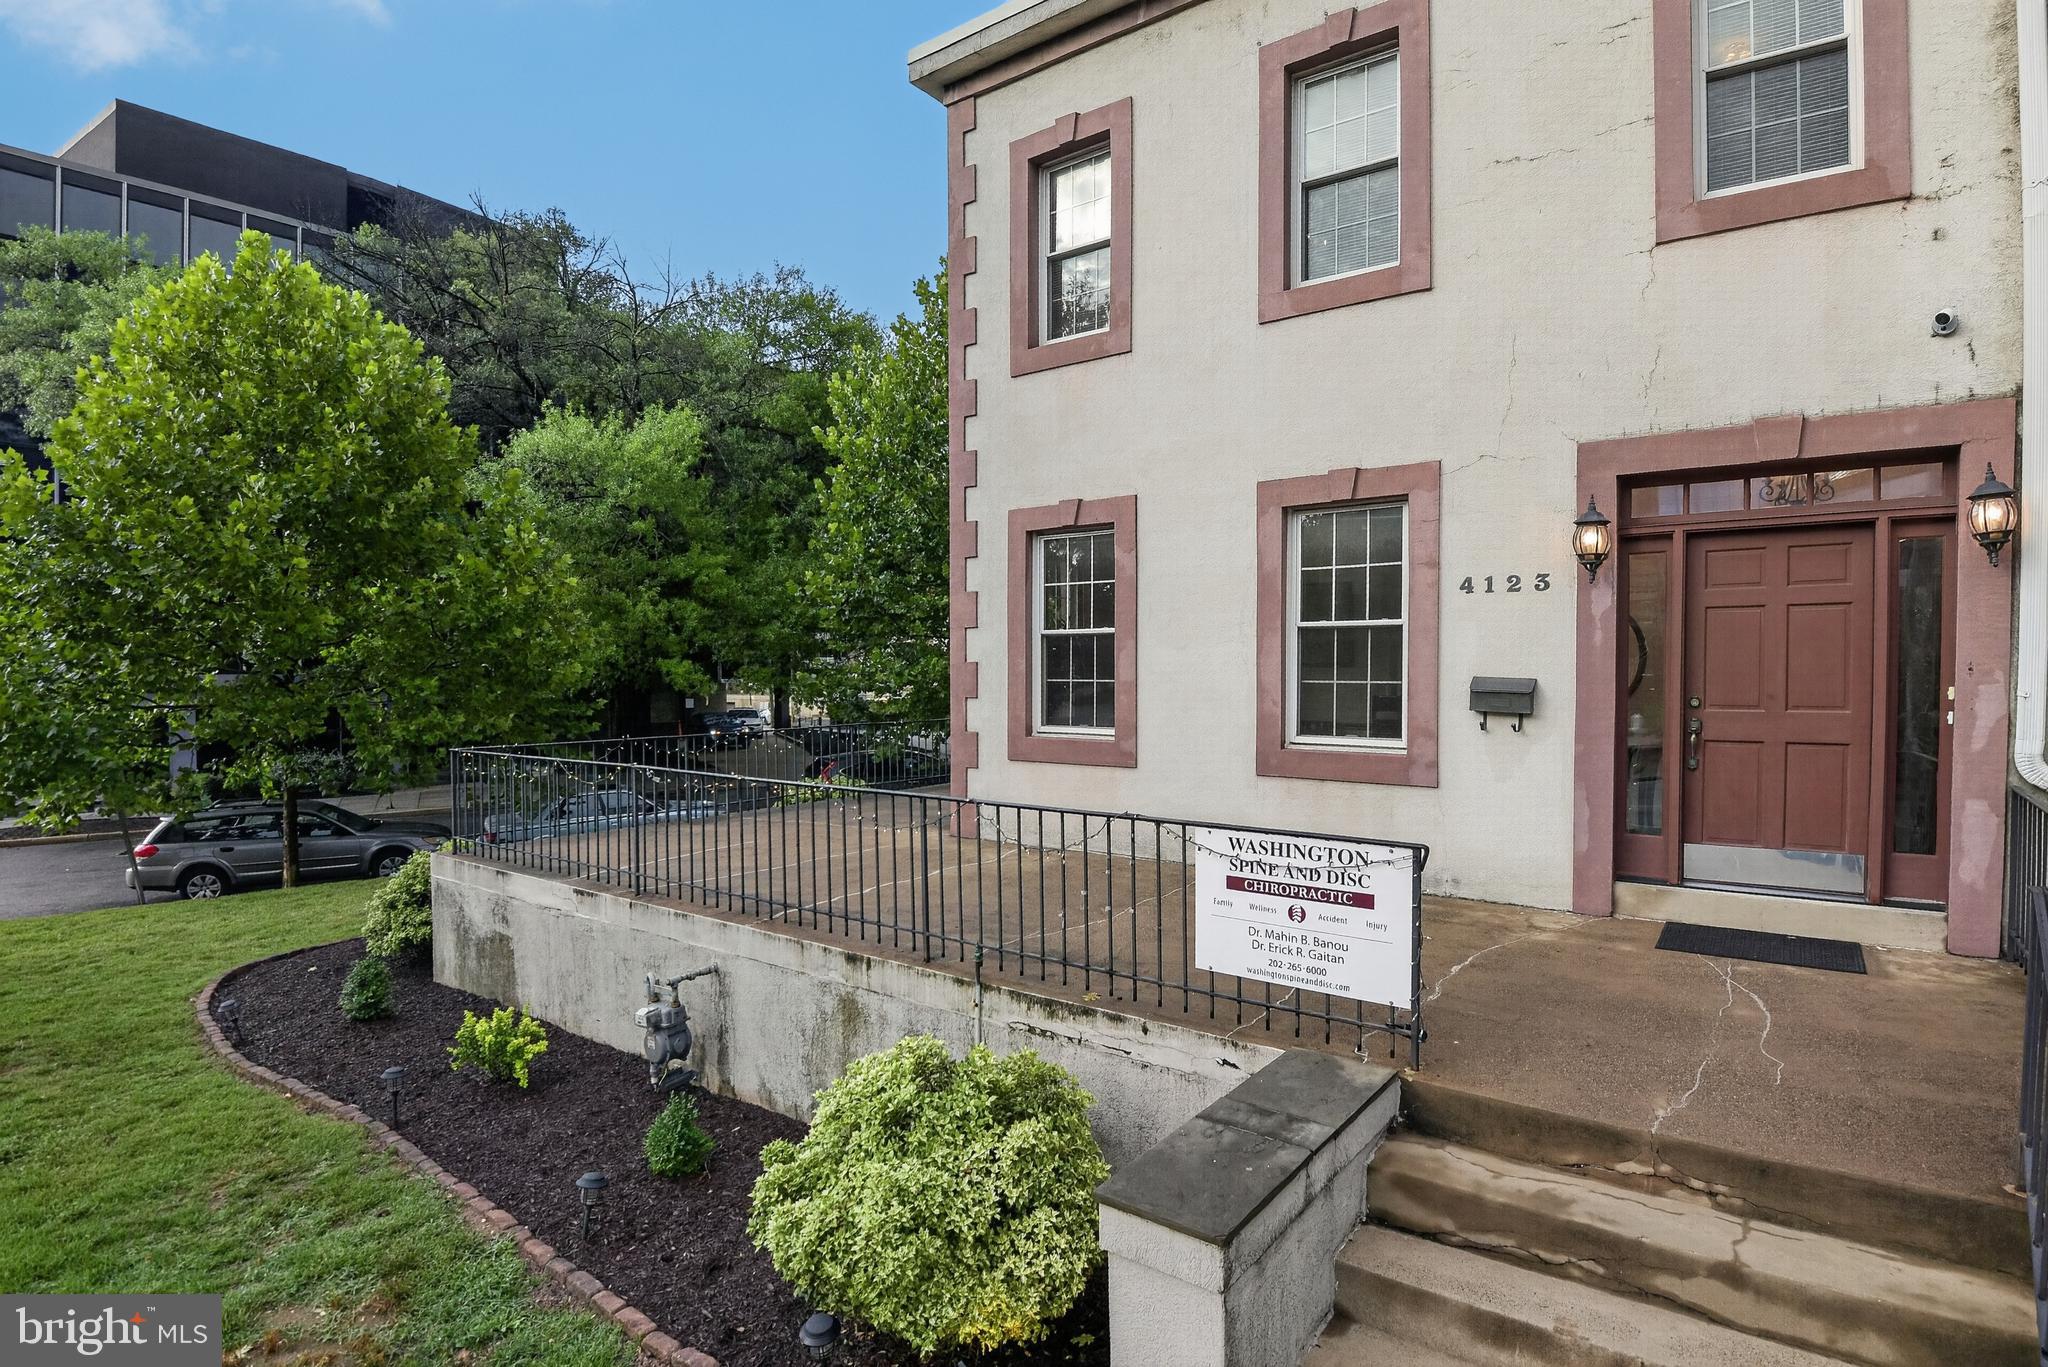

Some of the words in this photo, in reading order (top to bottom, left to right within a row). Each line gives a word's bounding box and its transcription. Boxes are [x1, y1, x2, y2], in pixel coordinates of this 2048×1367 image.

[1459, 573, 1551, 594] 4123
[1228, 836, 1370, 868] WASHINGTON
[1229, 858, 1279, 877] SPINE
[1283, 865, 1321, 882] AND
[1327, 869, 1371, 889] DISC
[1244, 879, 1354, 905] CHIROPRACTIC
[1213, 897, 1234, 909] Family
[1249, 903, 1278, 914] Wellness
[1318, 913, 1348, 925] Accident
[1365, 920, 1388, 933] Injury
[1248, 926, 1262, 938] Dr.
[1265, 928, 1298, 944] Mahin
[1301, 934, 1311, 946] B.
[1314, 937, 1349, 952] Banou
[1252, 940, 1266, 951] Dr.
[1268, 942, 1294, 956] Erick
[1297, 947, 1306, 959] R.
[1309, 950, 1345, 965] Gaitan
[1247, 967, 1350, 992] washingtonspineanddisc.com
